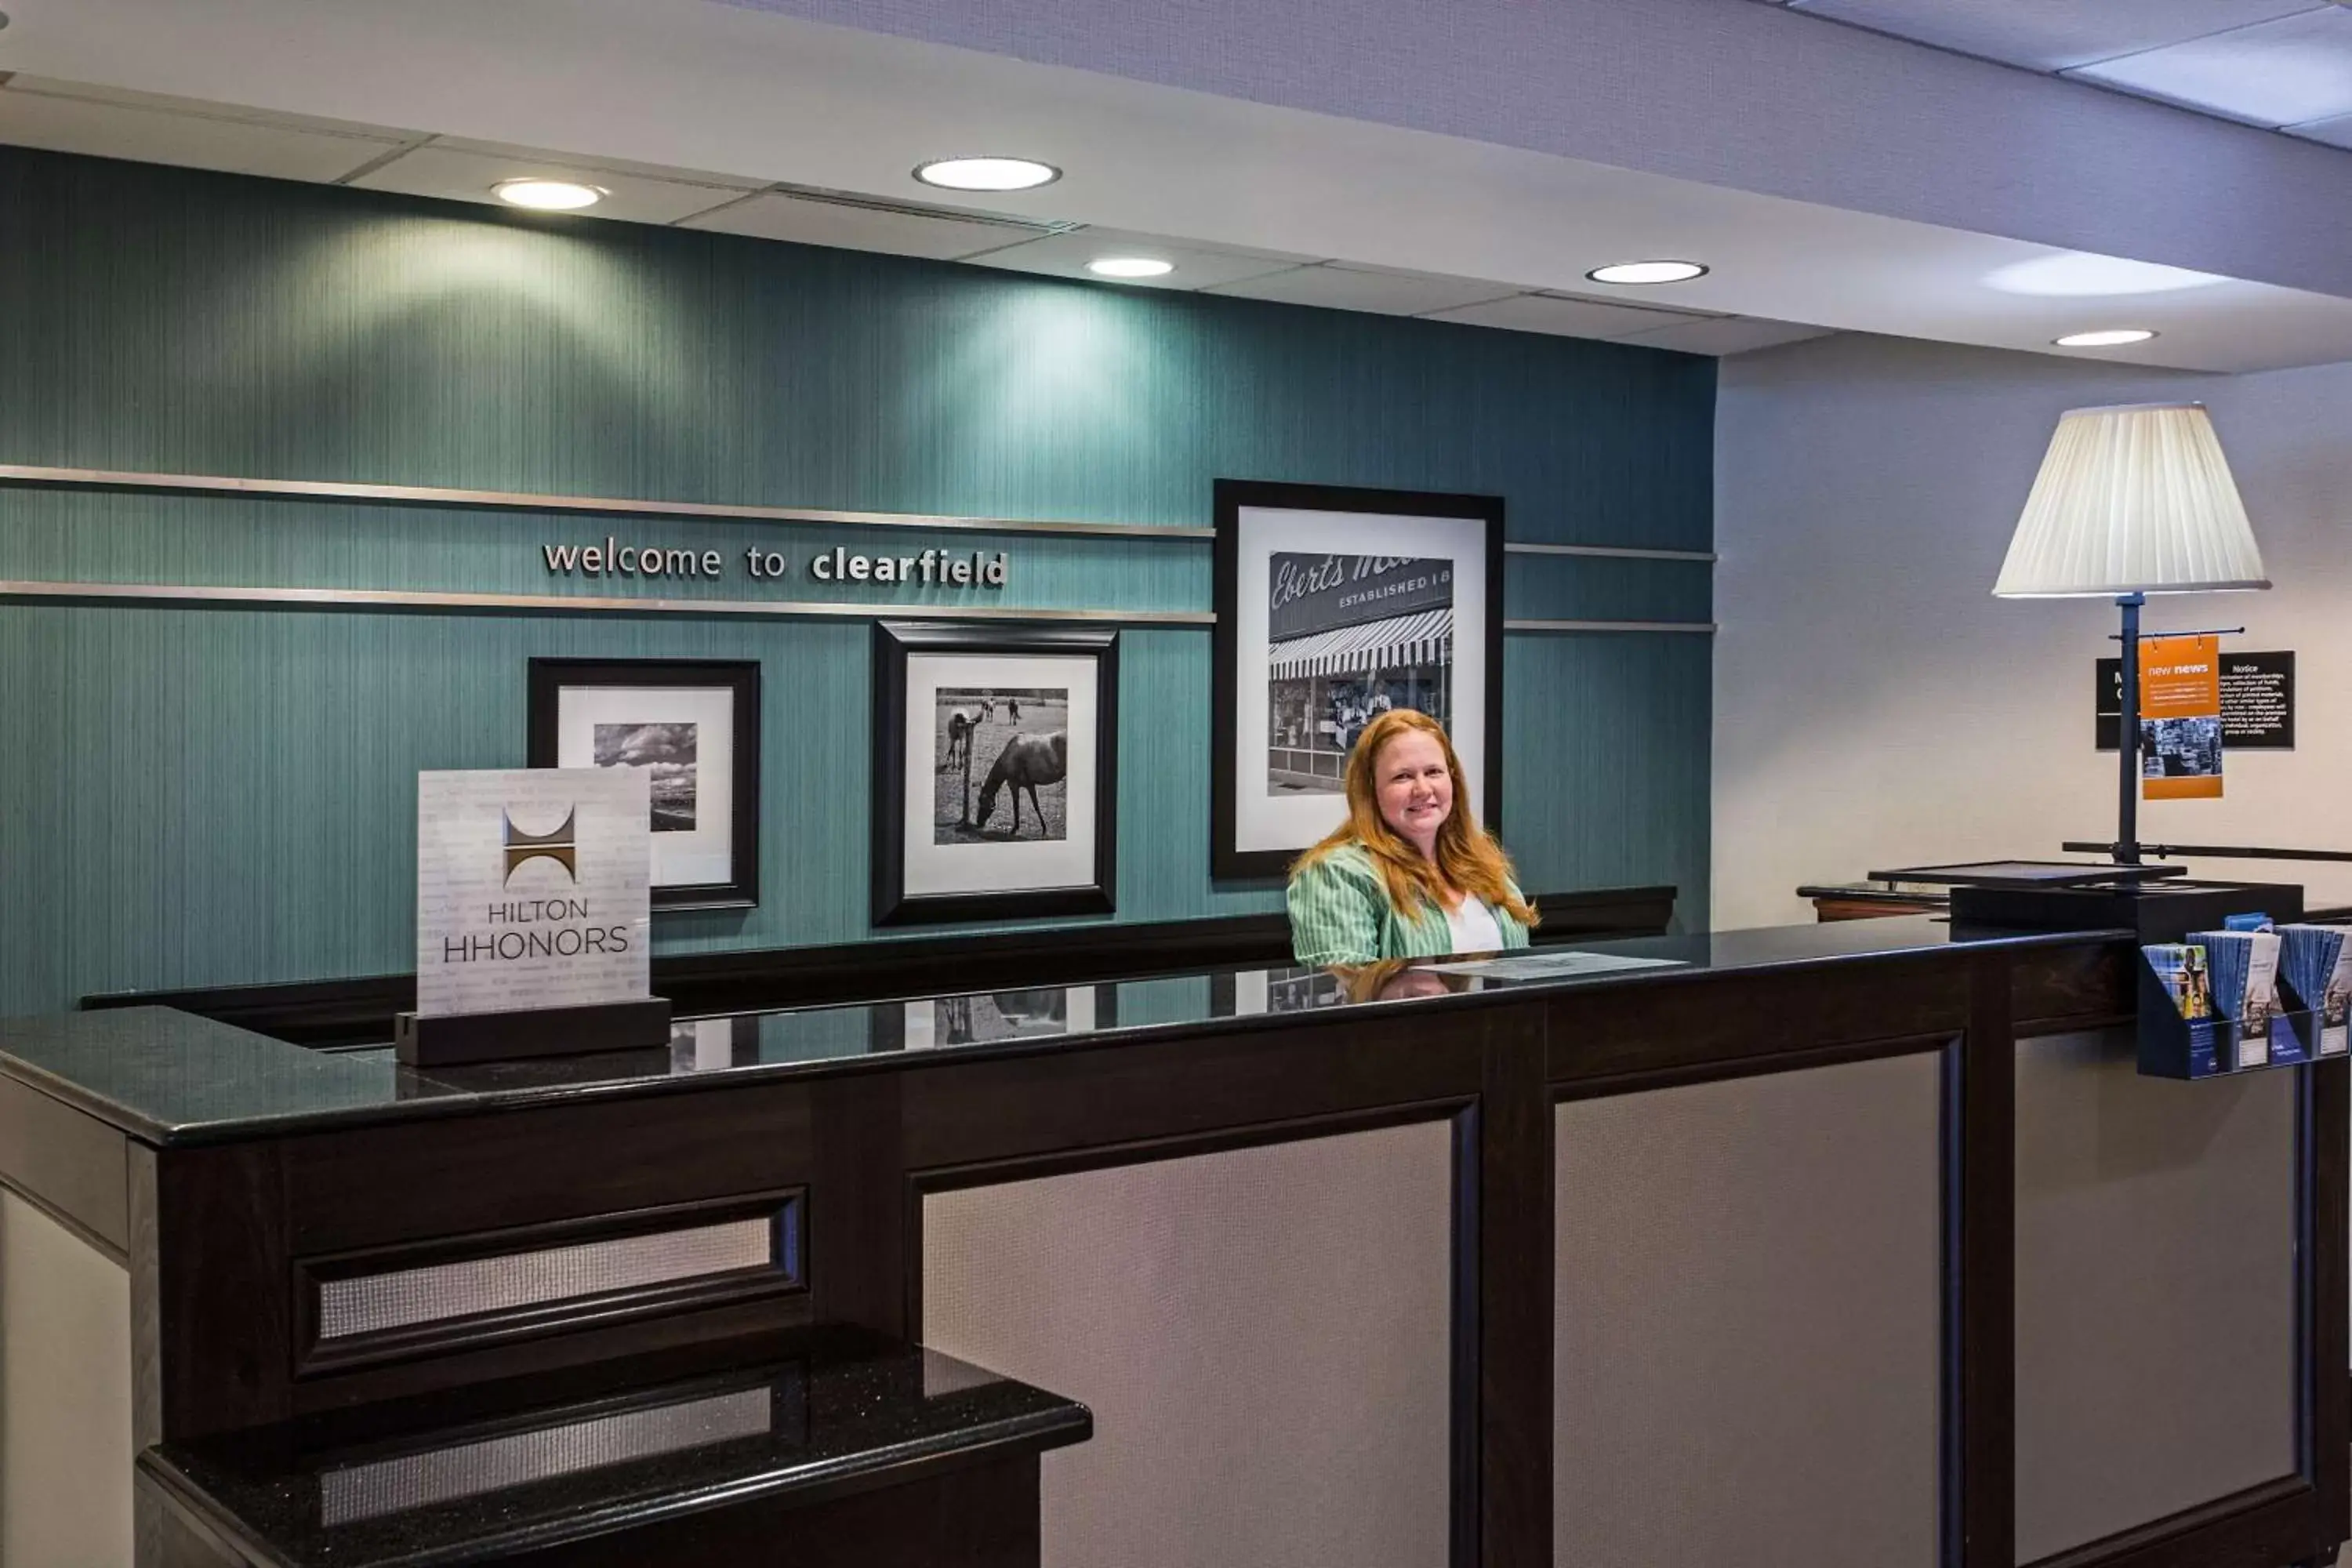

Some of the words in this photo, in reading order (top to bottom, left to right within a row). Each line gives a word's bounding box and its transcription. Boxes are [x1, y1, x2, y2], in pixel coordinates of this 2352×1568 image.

[544, 537, 720, 575] welcome
[748, 546, 785, 578] to
[812, 546, 1008, 585] clearfield
[1338, 576, 1427, 609] ESTABLISHED
[2148, 666, 2171, 677] new
[2174, 664, 2209, 675] news
[2232, 664, 2259, 673] Notice
[488, 898, 588, 924] HILTON
[444, 926, 629, 964] HHONORS
